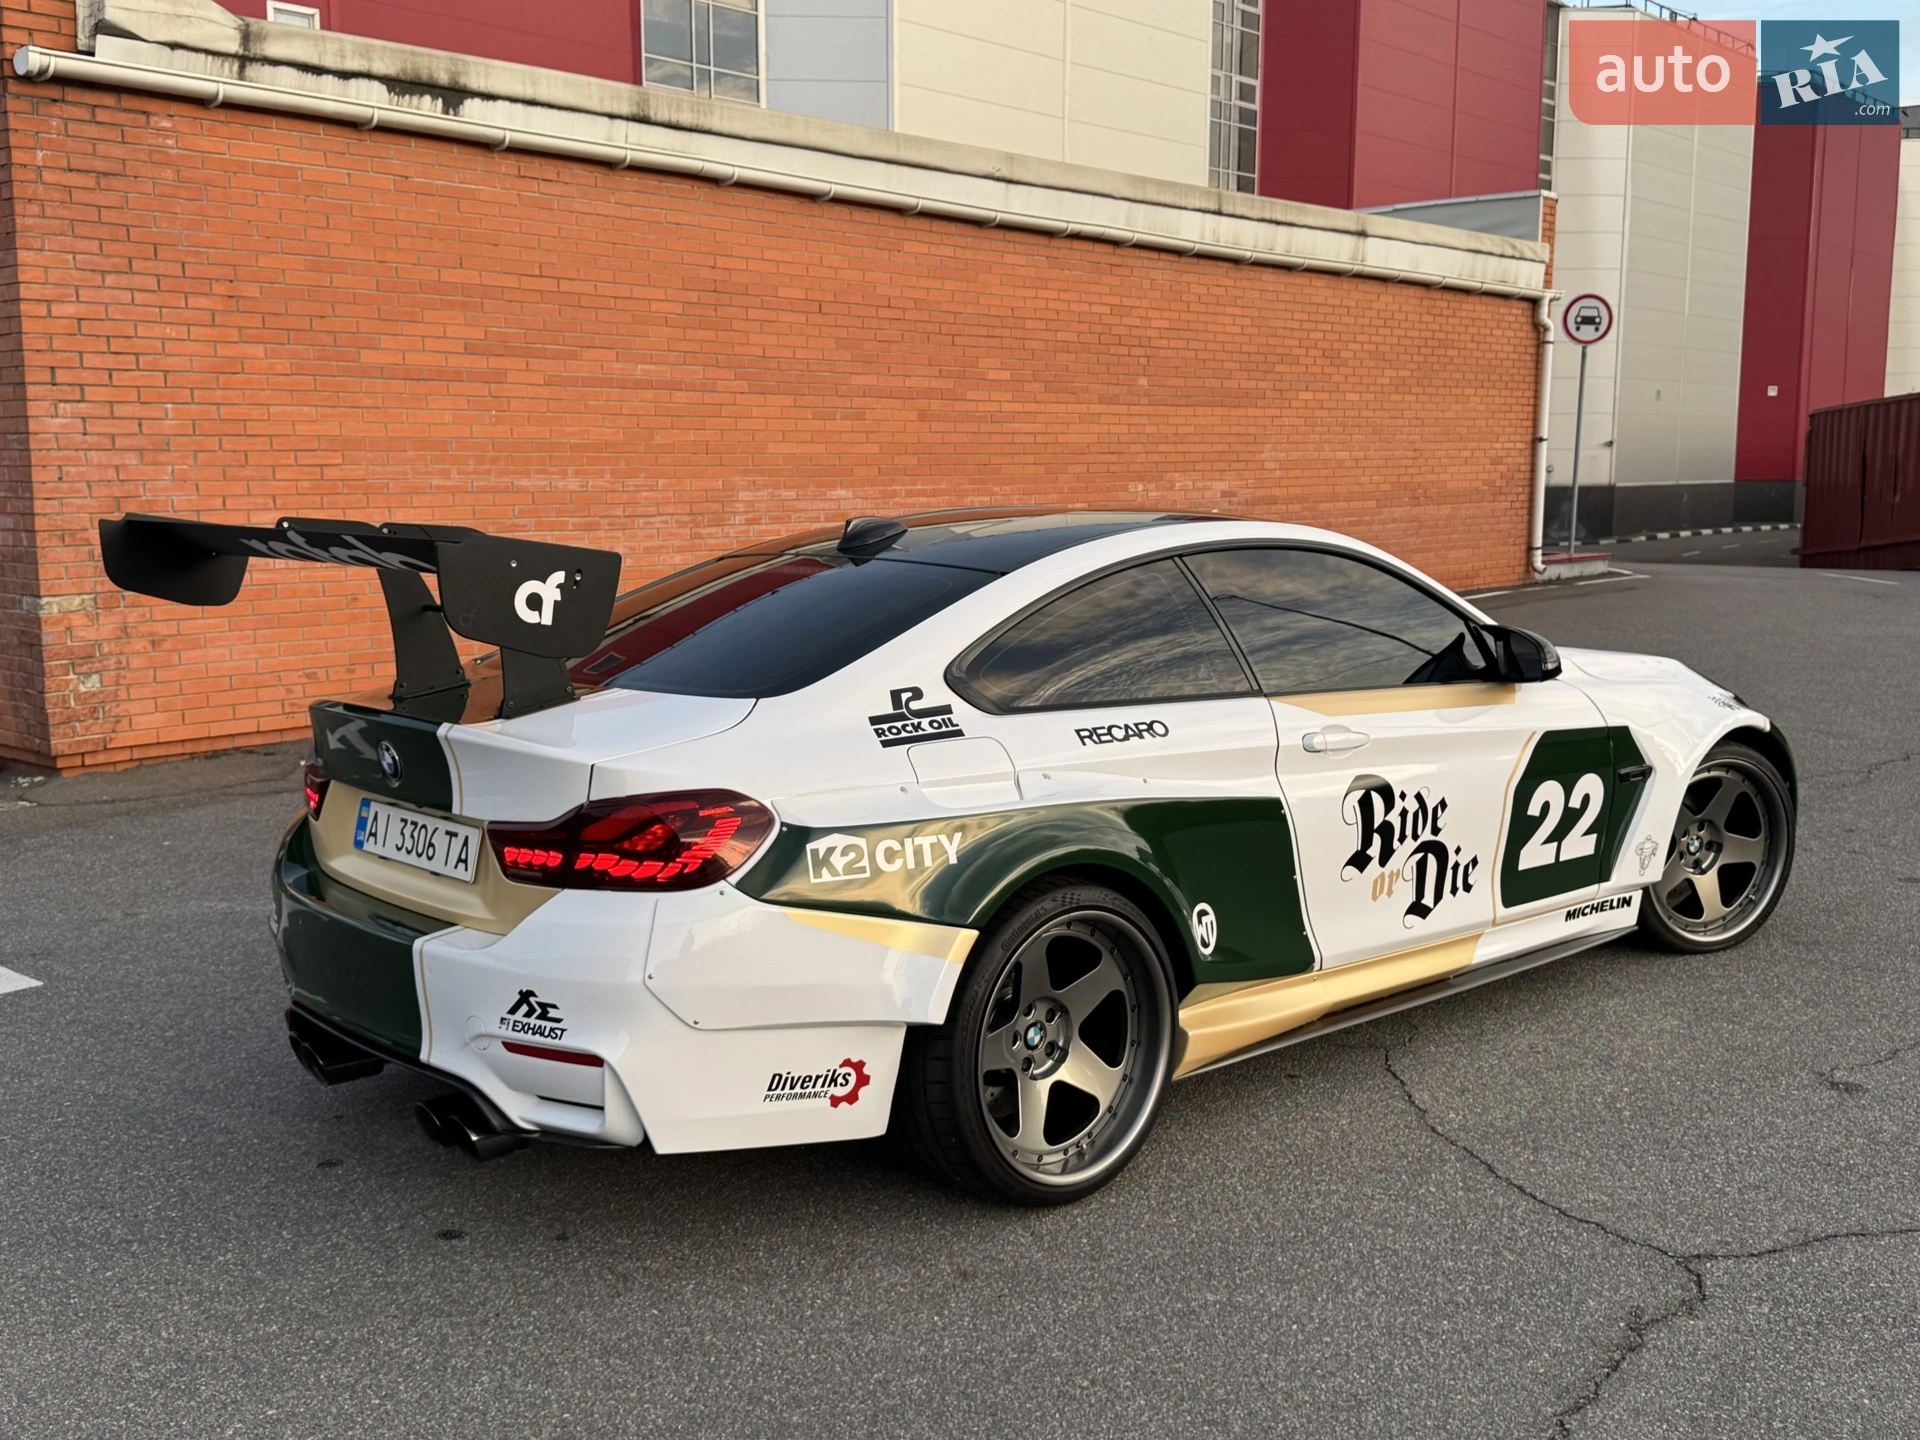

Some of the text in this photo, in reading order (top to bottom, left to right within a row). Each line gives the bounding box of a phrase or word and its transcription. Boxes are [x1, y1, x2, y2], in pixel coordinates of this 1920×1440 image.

[872, 716, 960, 739] ROCK OIL
[1073, 719, 1170, 747] RECARO
[1340, 773, 1449, 882] Ride
[1518, 772, 1605, 872] 22
[366, 810, 470, 873] AI 3306 TA
[809, 831, 963, 880] K2 CITY
[1371, 839, 1480, 929] or Die
[1564, 895, 1634, 923] MICHELIN
[511, 1019, 568, 1041] EXHAUST
[766, 1068, 852, 1093] Diveriks
[763, 1089, 830, 1103] PERFORMANCE
